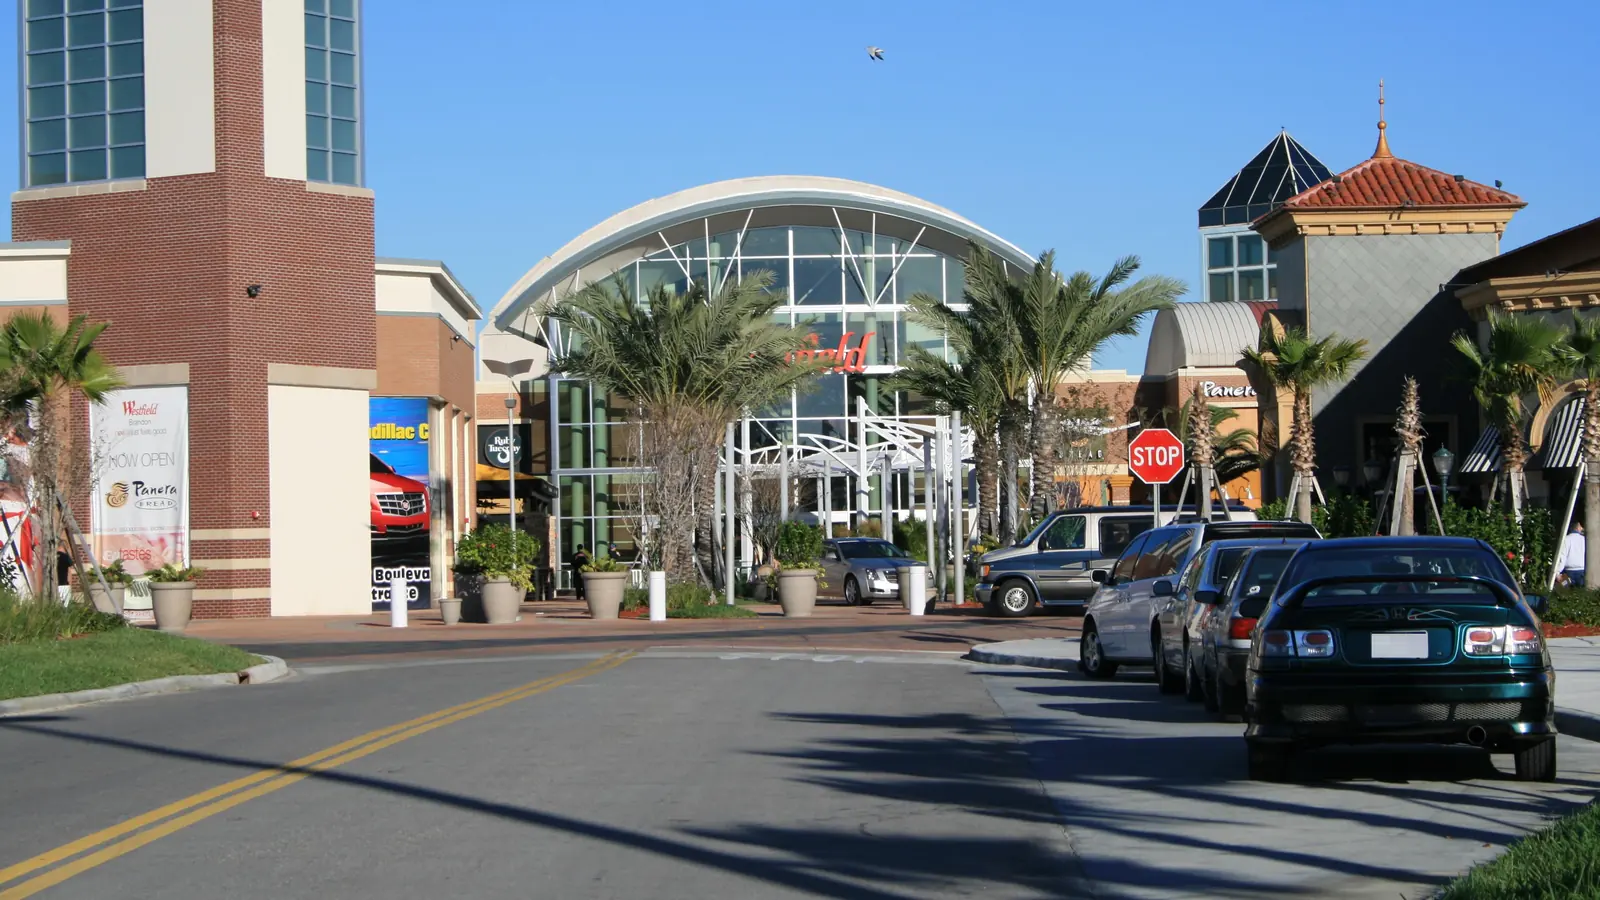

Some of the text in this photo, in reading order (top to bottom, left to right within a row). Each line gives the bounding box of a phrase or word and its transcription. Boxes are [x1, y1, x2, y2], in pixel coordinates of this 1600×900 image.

[1200, 381, 1257, 397] Paner
[122, 400, 158, 416] Westfield
[108, 452, 175, 468] NOW OPEN
[1133, 446, 1180, 467] STOP
[132, 480, 177, 496] Panera
[371, 587, 418, 601] trae
